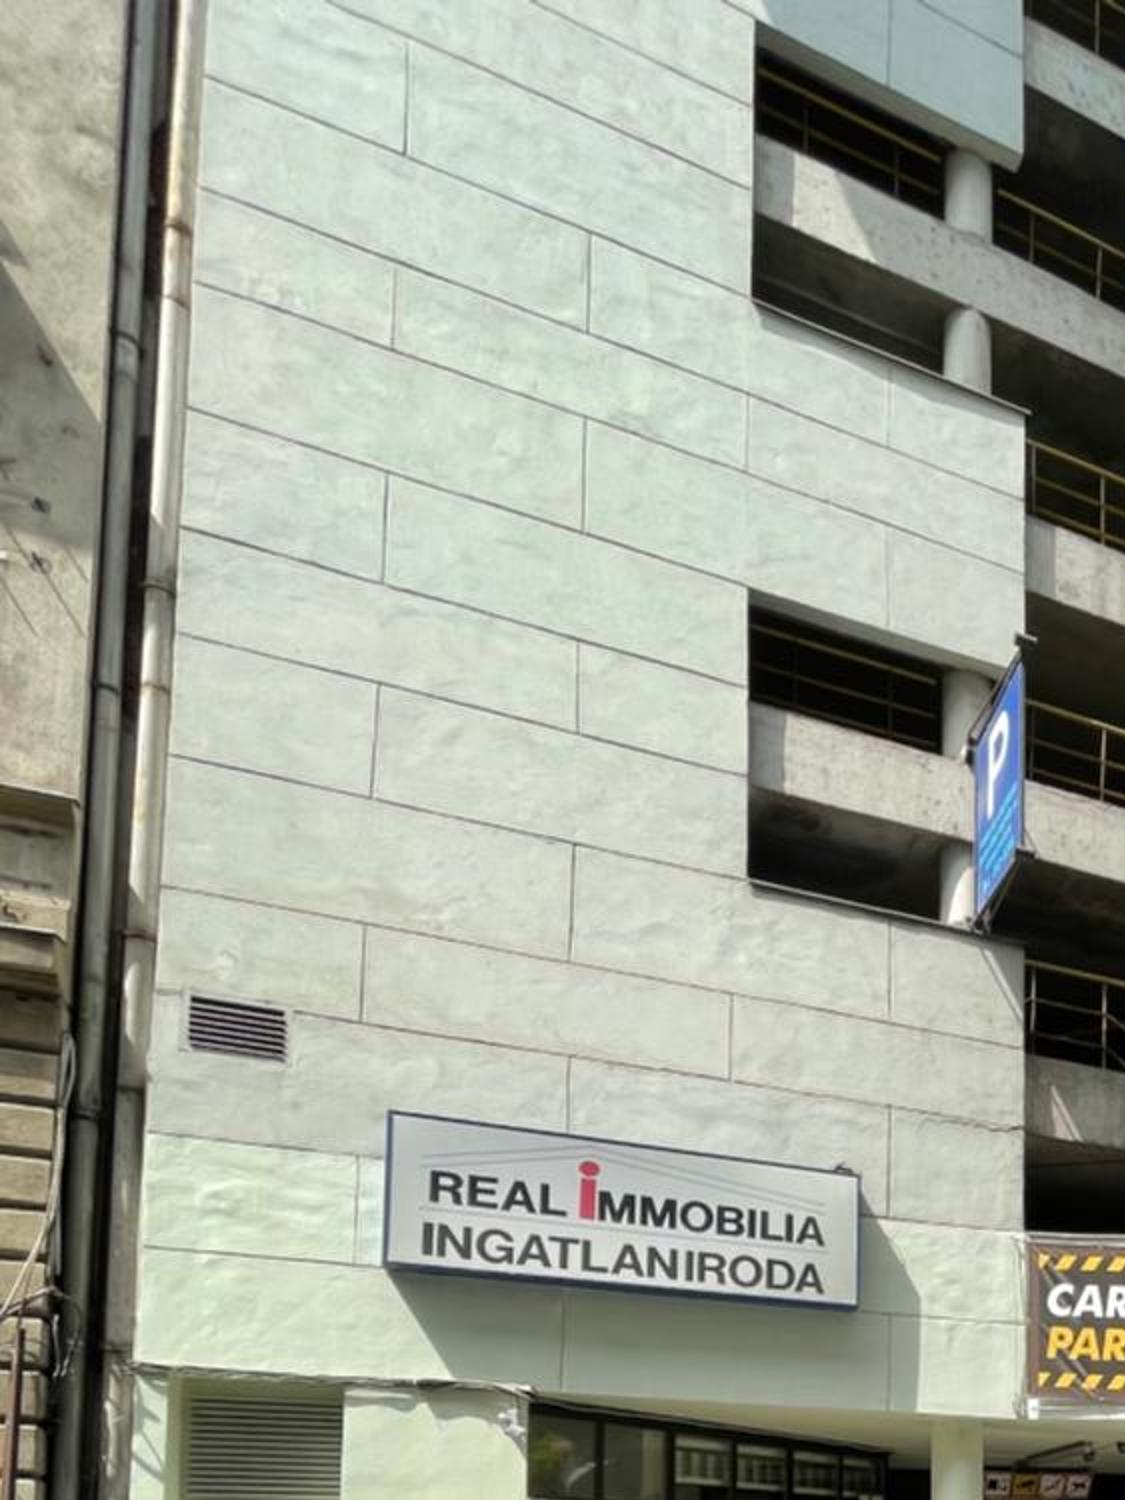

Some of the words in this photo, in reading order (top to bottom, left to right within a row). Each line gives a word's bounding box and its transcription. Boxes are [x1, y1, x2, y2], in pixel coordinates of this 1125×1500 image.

[988, 710, 1010, 820] P
[429, 1170, 567, 1217] REAL
[421, 1222, 825, 1294] INGATLANIRODA
